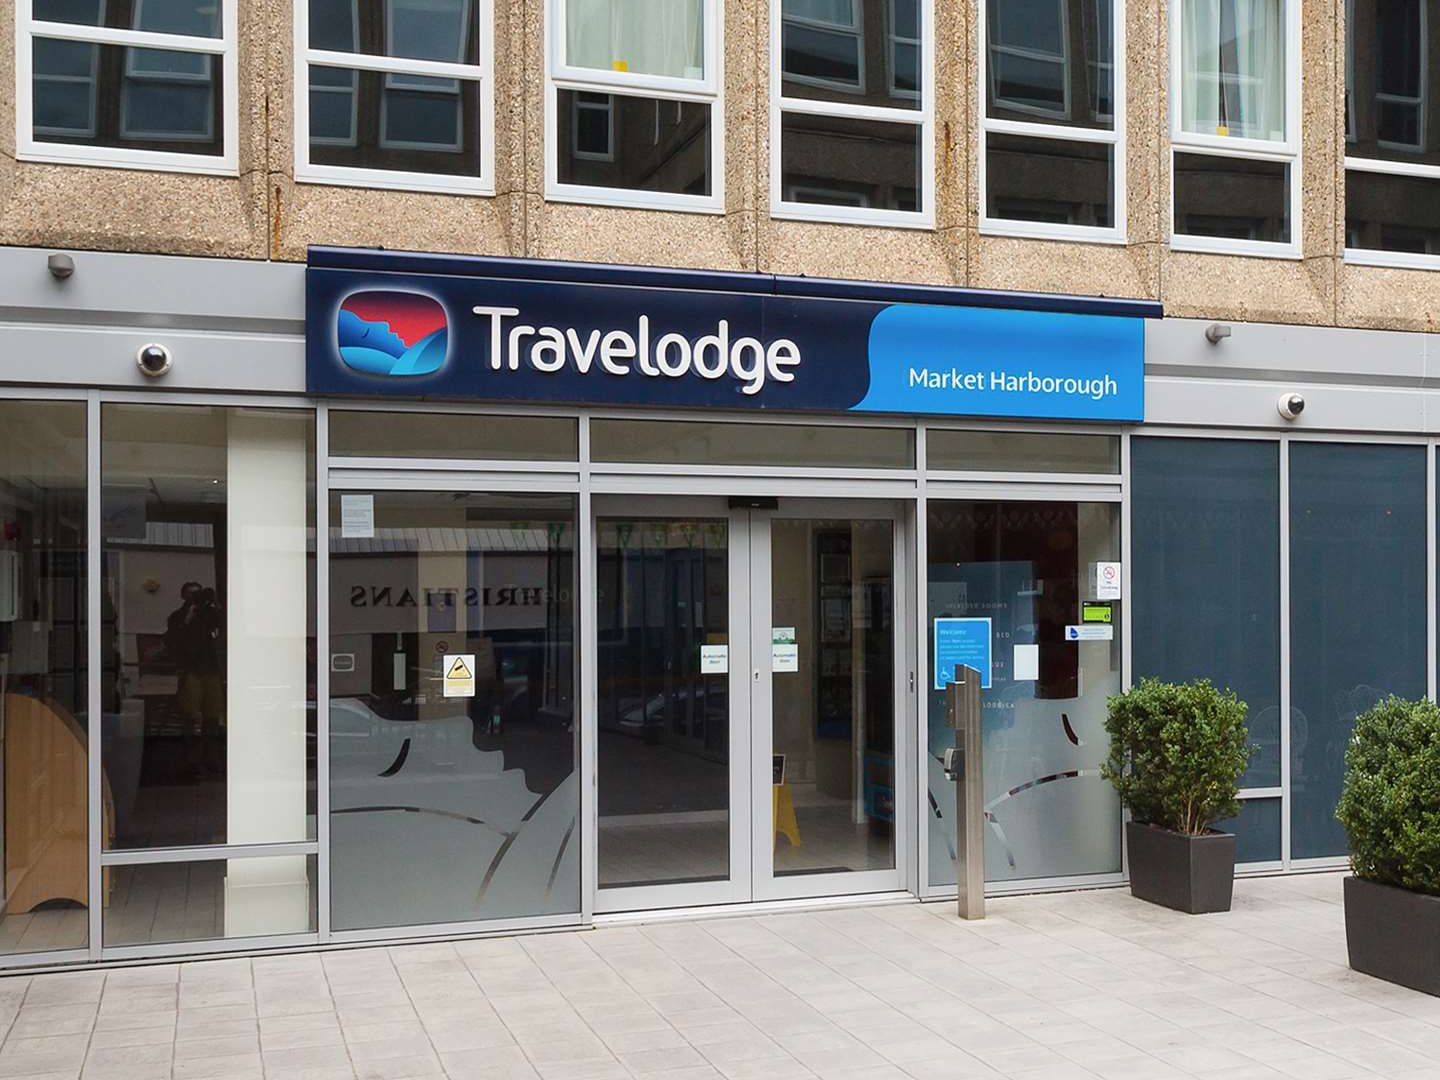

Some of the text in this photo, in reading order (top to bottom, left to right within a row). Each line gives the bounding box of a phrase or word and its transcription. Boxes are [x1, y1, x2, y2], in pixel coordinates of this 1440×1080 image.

[473, 306, 801, 394] Travelodge
[909, 367, 1118, 400] Market Harborough
